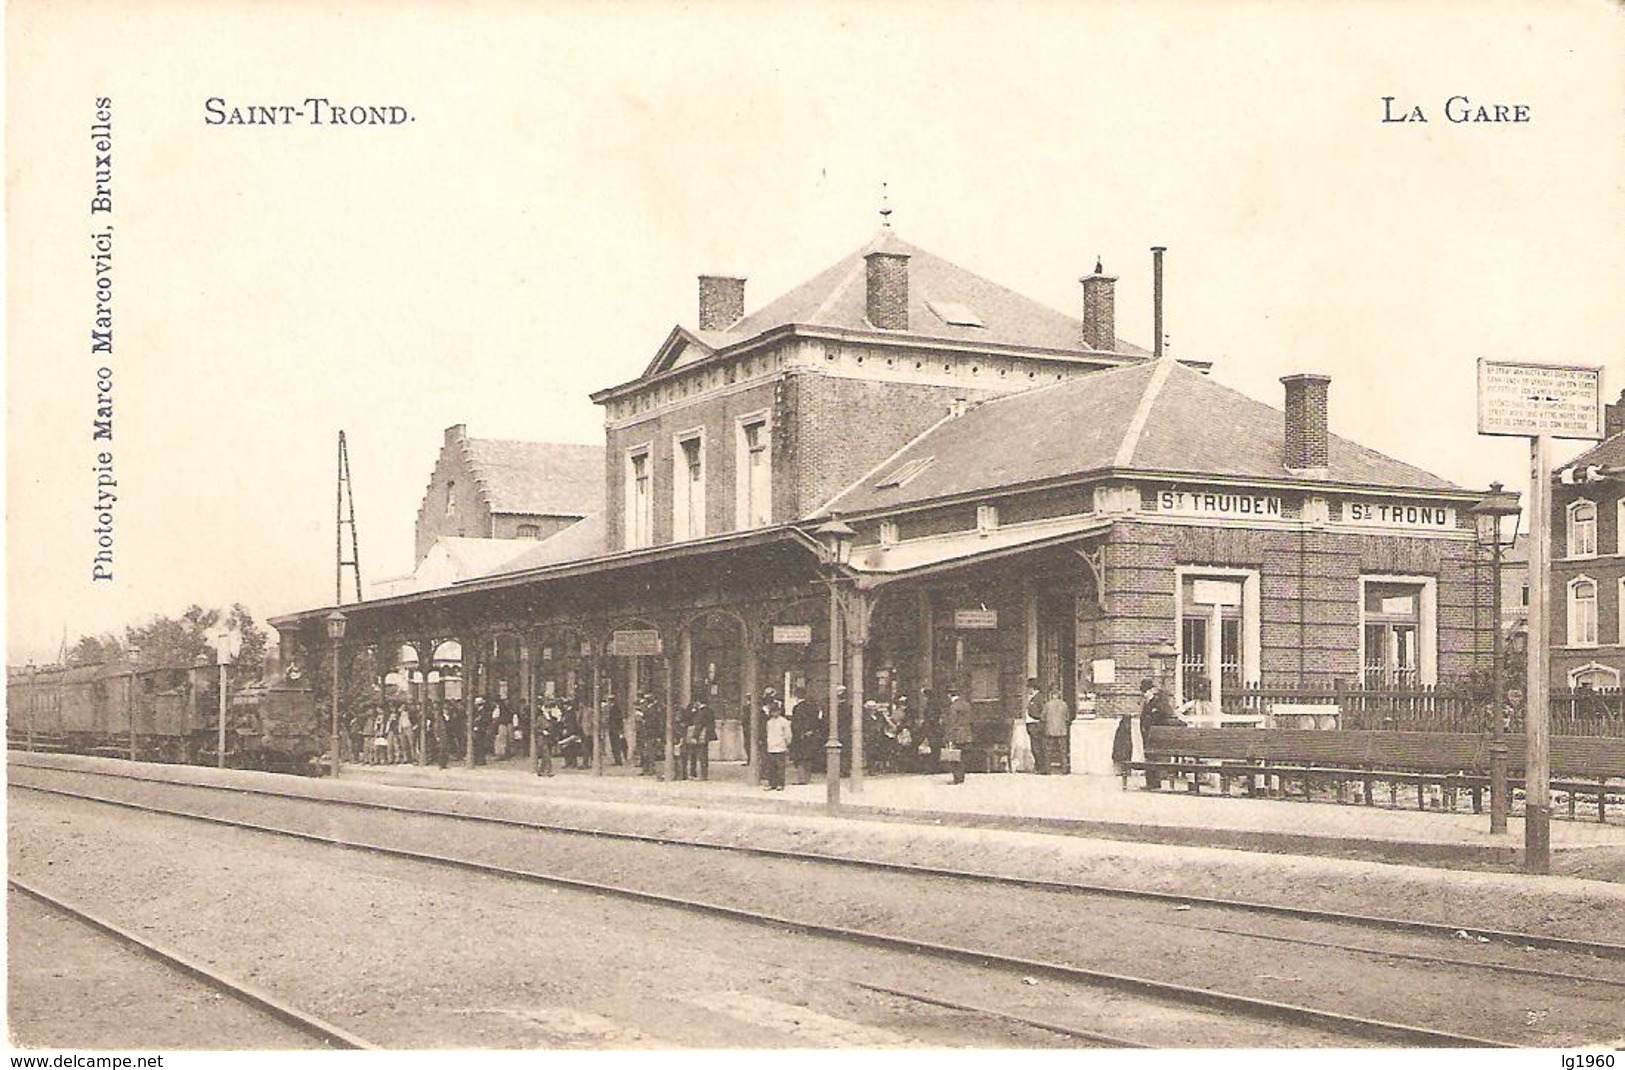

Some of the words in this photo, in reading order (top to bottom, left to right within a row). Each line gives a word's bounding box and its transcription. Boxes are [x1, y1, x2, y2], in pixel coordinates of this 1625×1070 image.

[91, 97, 112, 215] Bruxelles
[91, 225, 114, 354] Marcovici,
[92, 367, 113, 441] Marco
[92, 453, 118, 582] Phototypie
[1191, 494, 1279, 514] TRUIDEN
[1378, 506, 1446, 525] TROND
